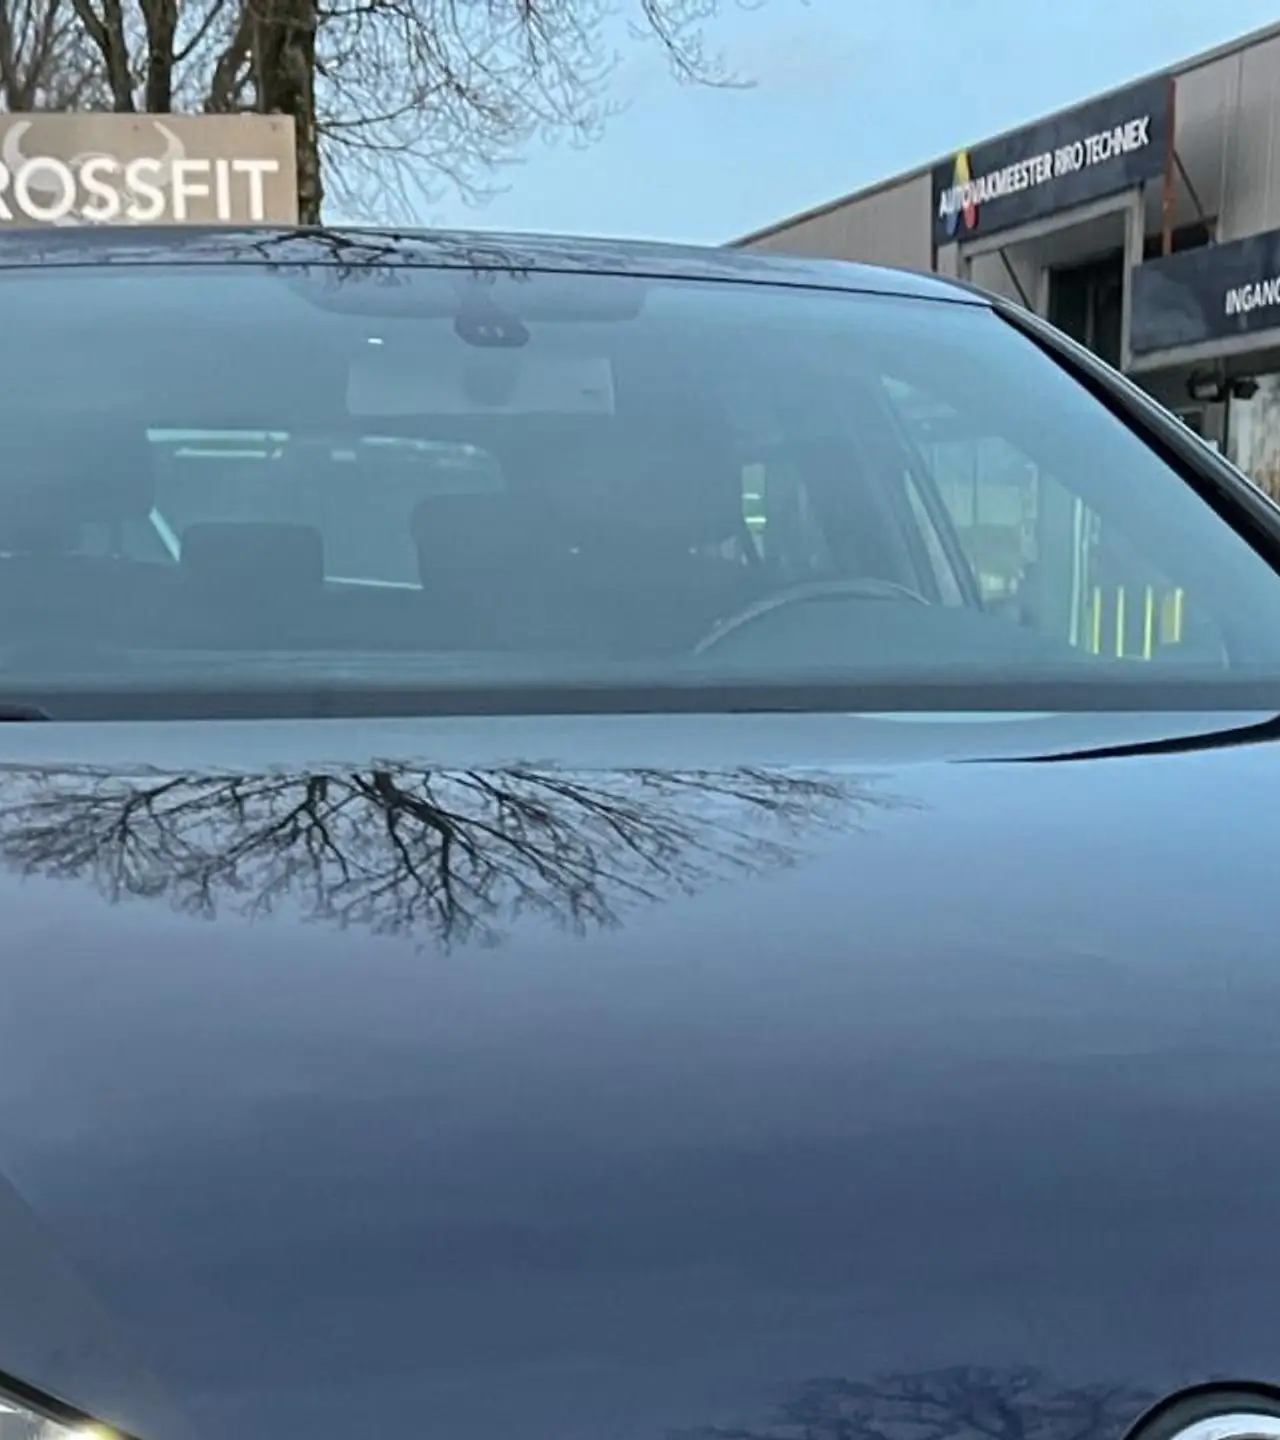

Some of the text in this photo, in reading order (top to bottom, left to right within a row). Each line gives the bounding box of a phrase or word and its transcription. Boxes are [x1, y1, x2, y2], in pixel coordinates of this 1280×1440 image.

[939, 115, 1150, 217] AUTOVAKMEESTER RIRO TECHNIEK
